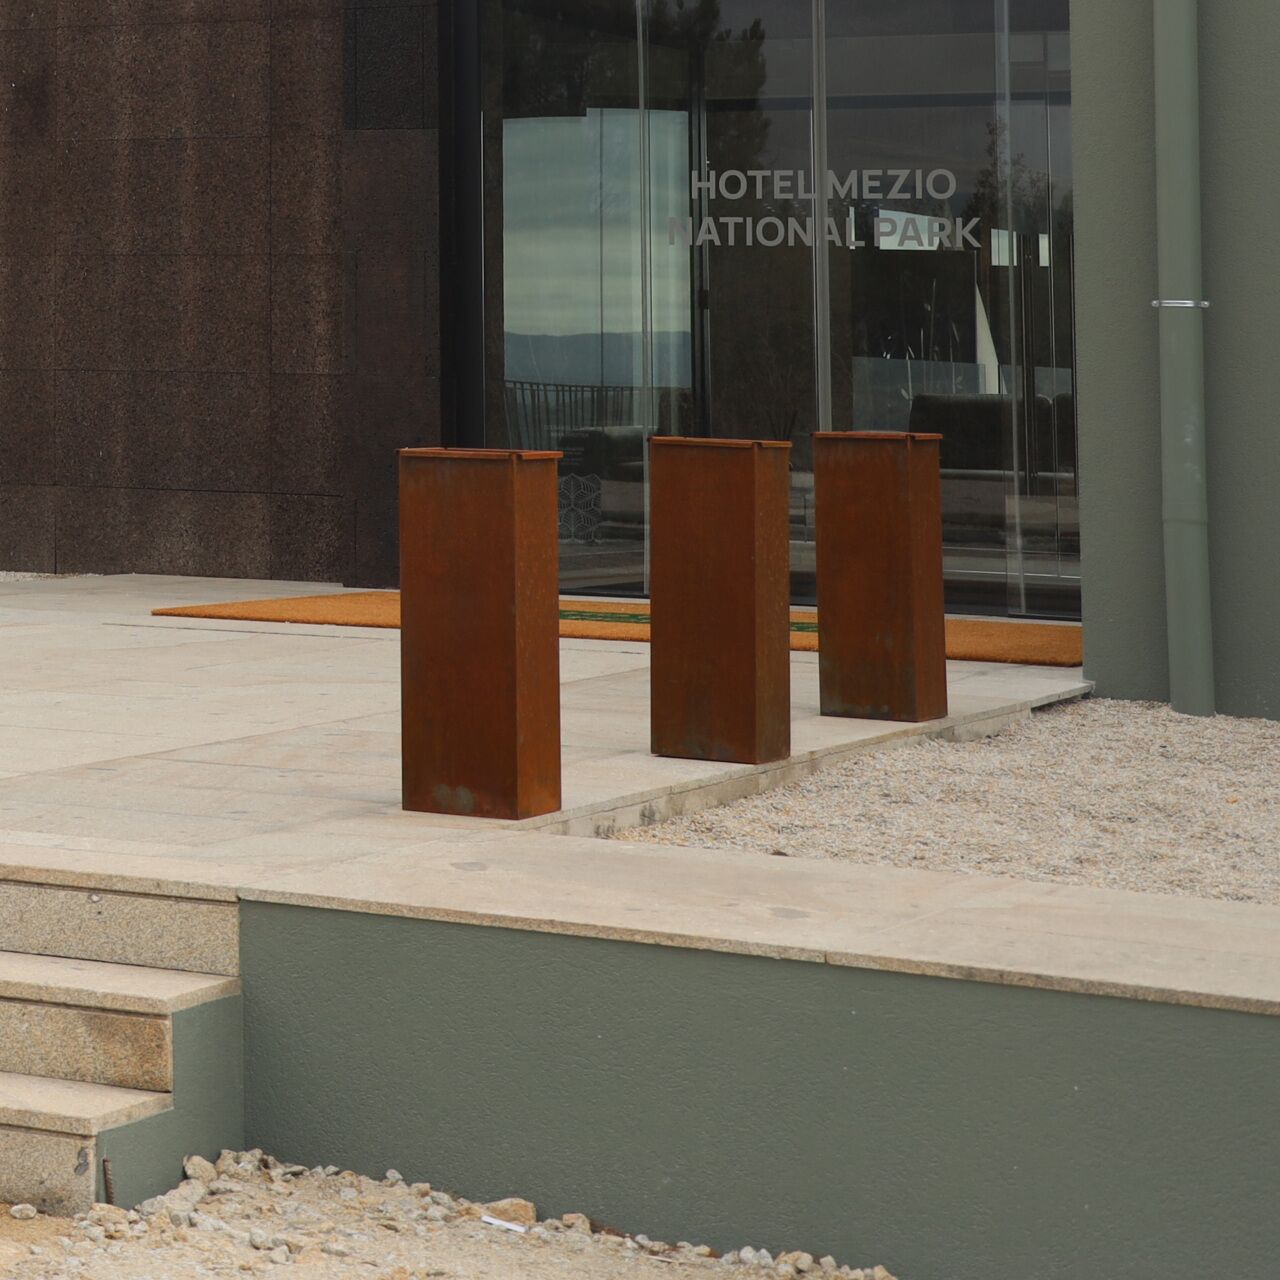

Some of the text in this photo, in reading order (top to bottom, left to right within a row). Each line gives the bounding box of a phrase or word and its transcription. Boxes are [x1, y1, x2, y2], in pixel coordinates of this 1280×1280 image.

[691, 169, 957, 200] HOTEL MEZIO
[667, 216, 982, 248] NATIONAL PARK
